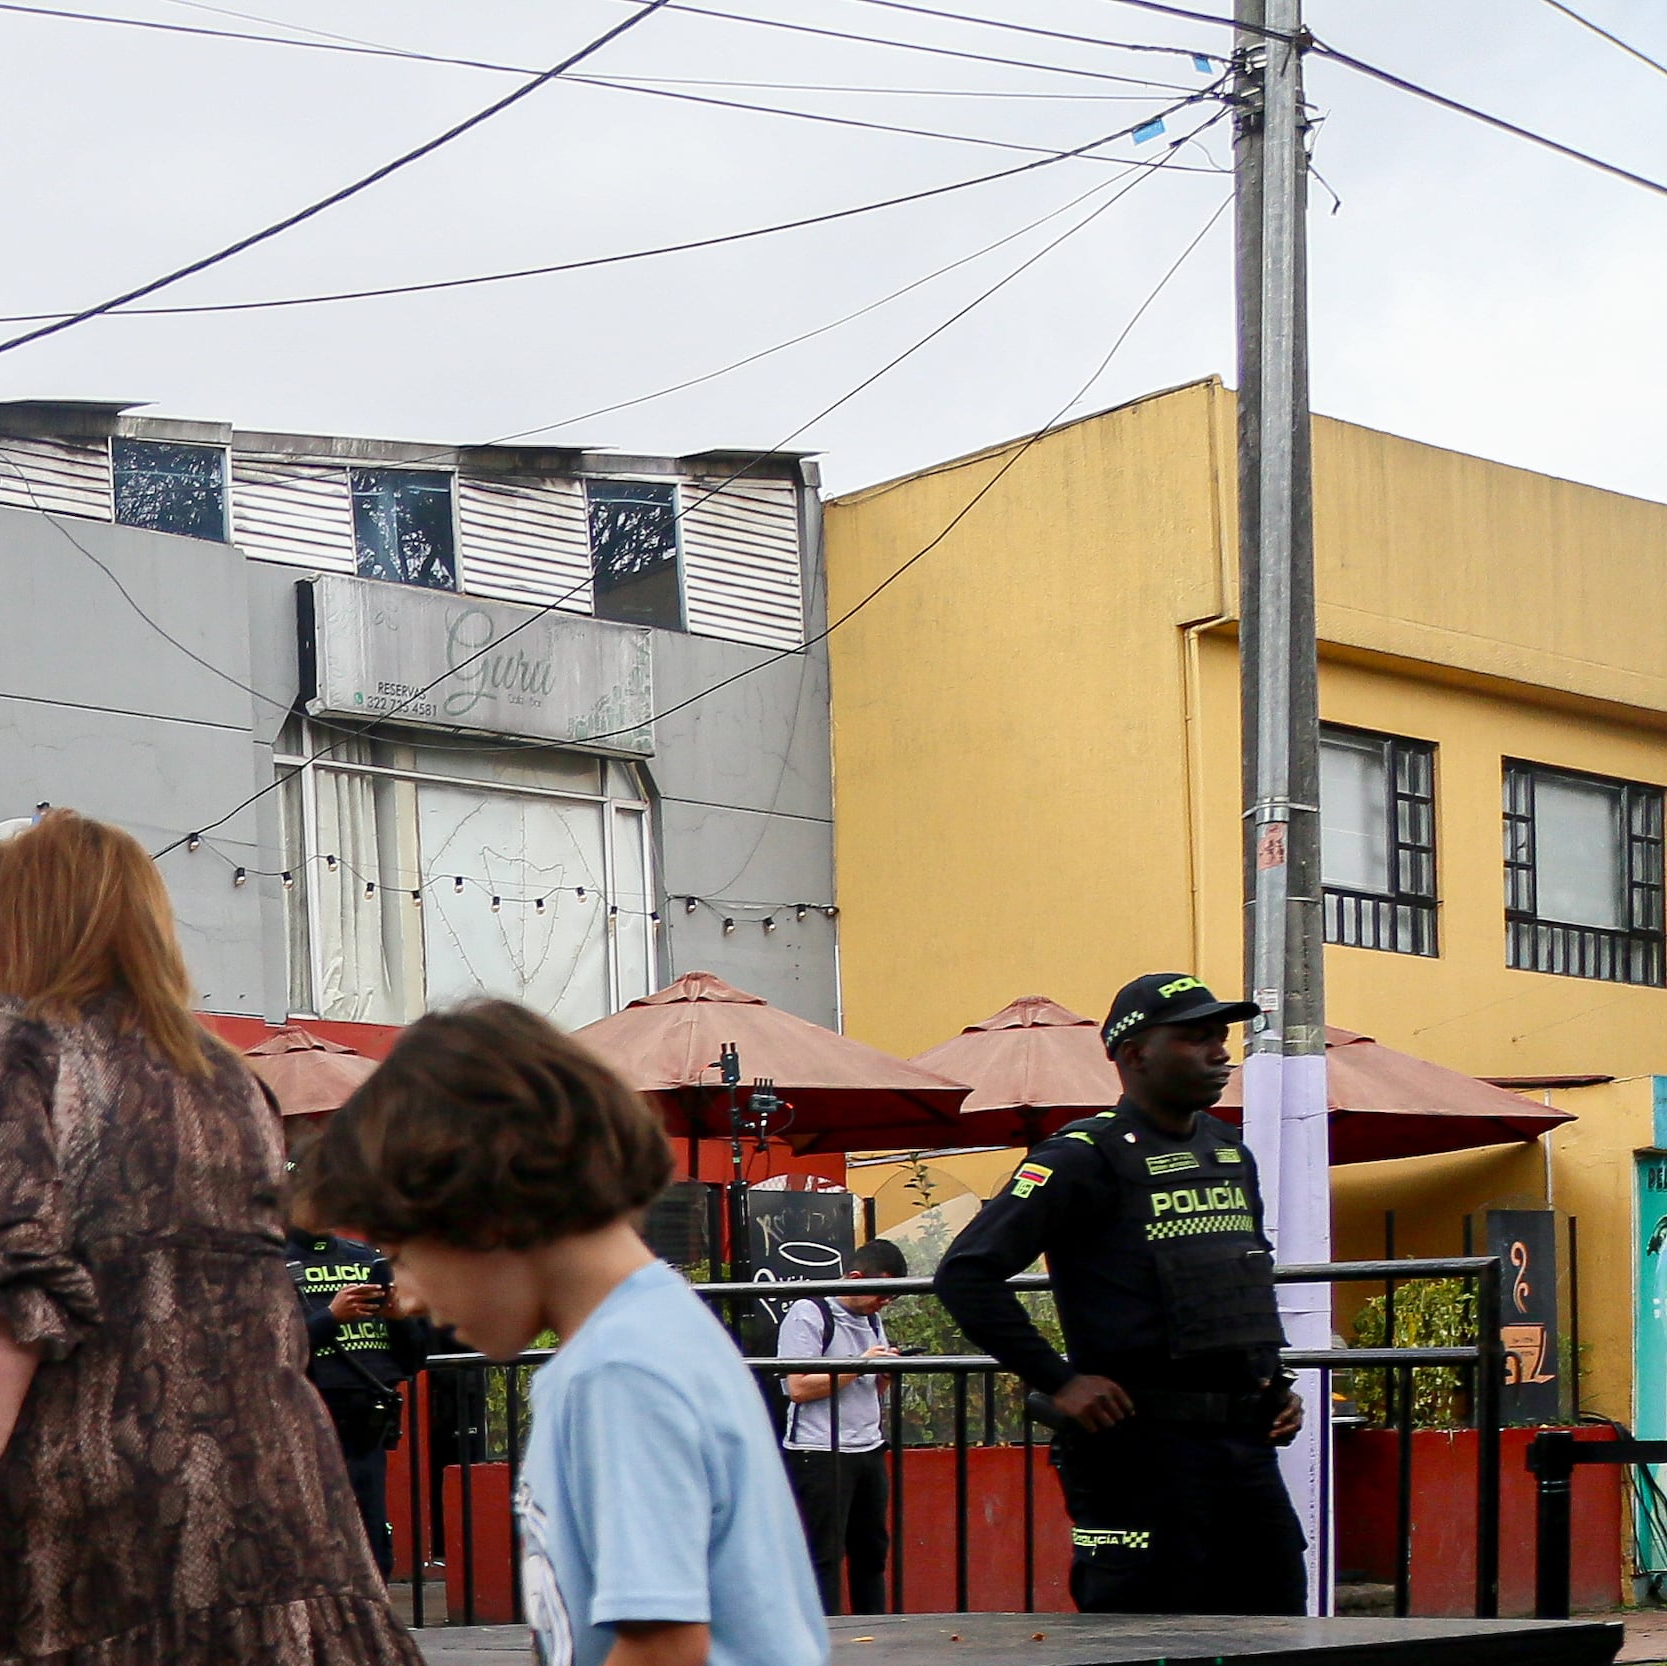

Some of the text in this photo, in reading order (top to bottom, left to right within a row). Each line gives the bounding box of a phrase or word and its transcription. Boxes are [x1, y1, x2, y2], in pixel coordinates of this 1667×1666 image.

[377, 681, 427, 700] RESERVAS
[367, 695, 387, 710] 322
[1150, 1180, 1249, 1217] POLICÍA
